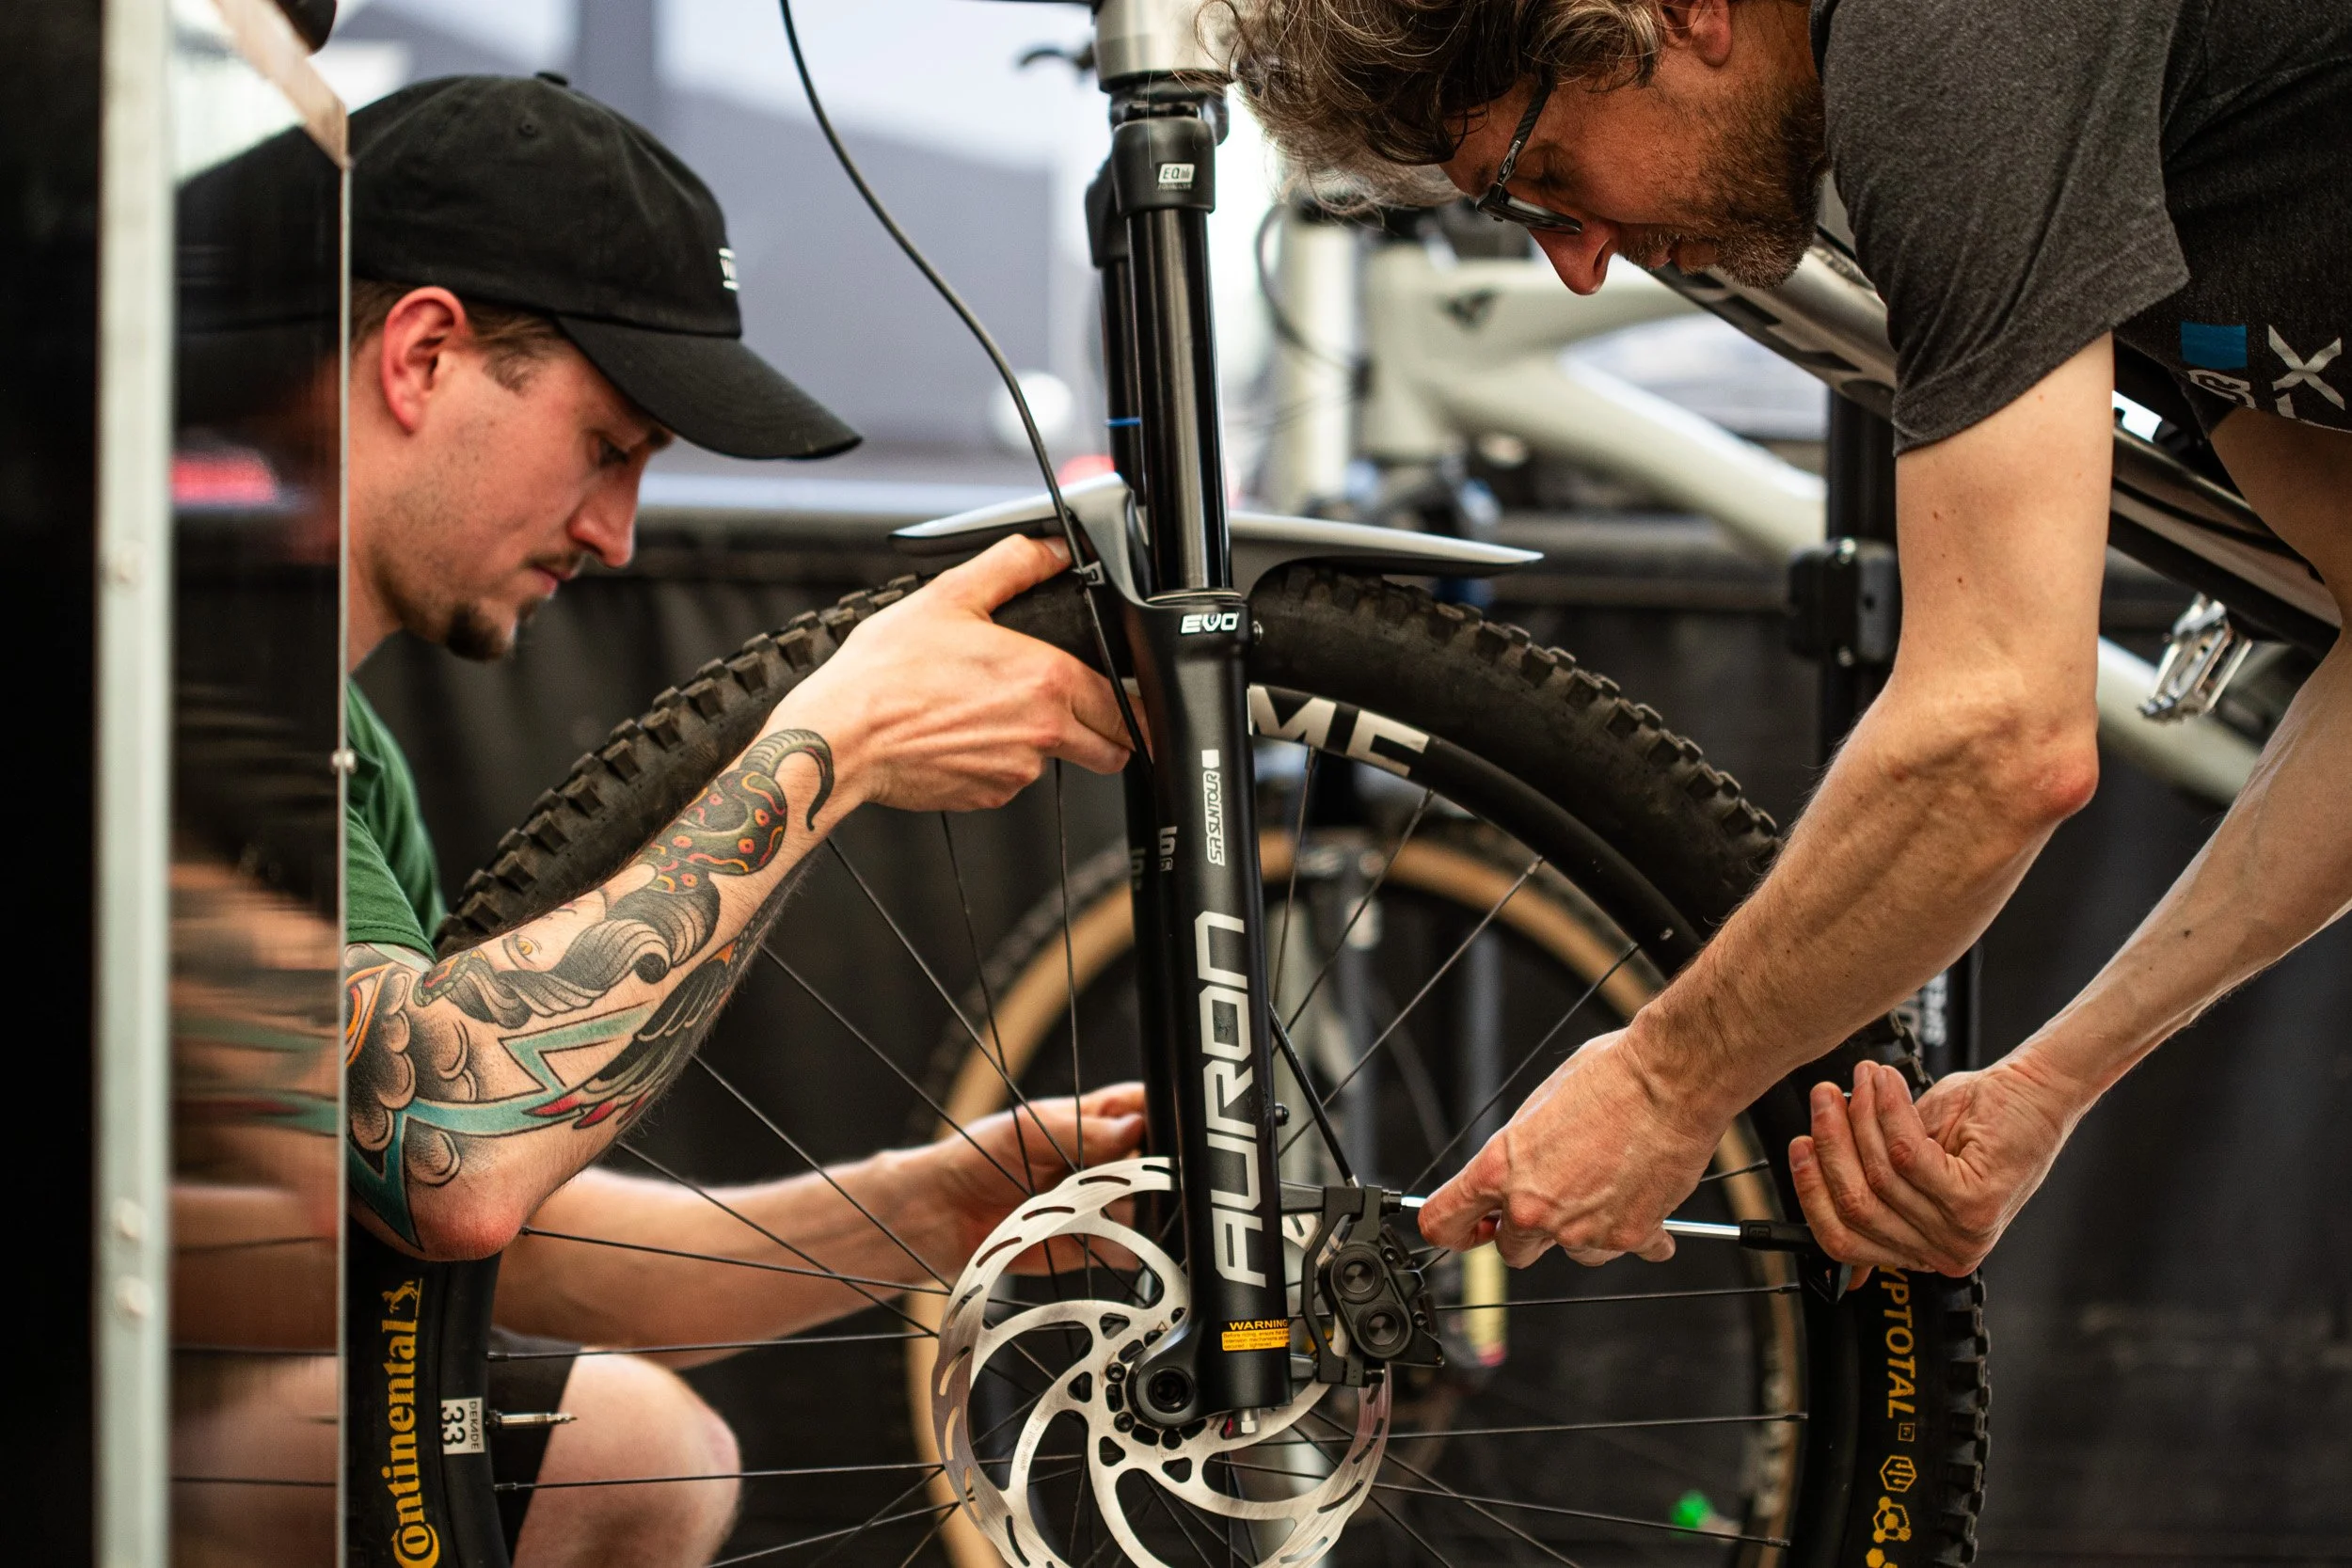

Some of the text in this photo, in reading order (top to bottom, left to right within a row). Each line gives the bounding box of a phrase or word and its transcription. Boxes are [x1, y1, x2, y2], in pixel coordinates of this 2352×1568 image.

[1181, 611, 1240, 634] EVO
[1202, 769, 1224, 835] SUNTOUR
[1194, 911, 1267, 1288] AURON
[1230, 1319, 1288, 1331] WARNING
[1880, 1266, 1916, 1419] YPTOTAL
[382, 1317, 440, 1568] Continental
[439, 1406, 466, 1446] 33
